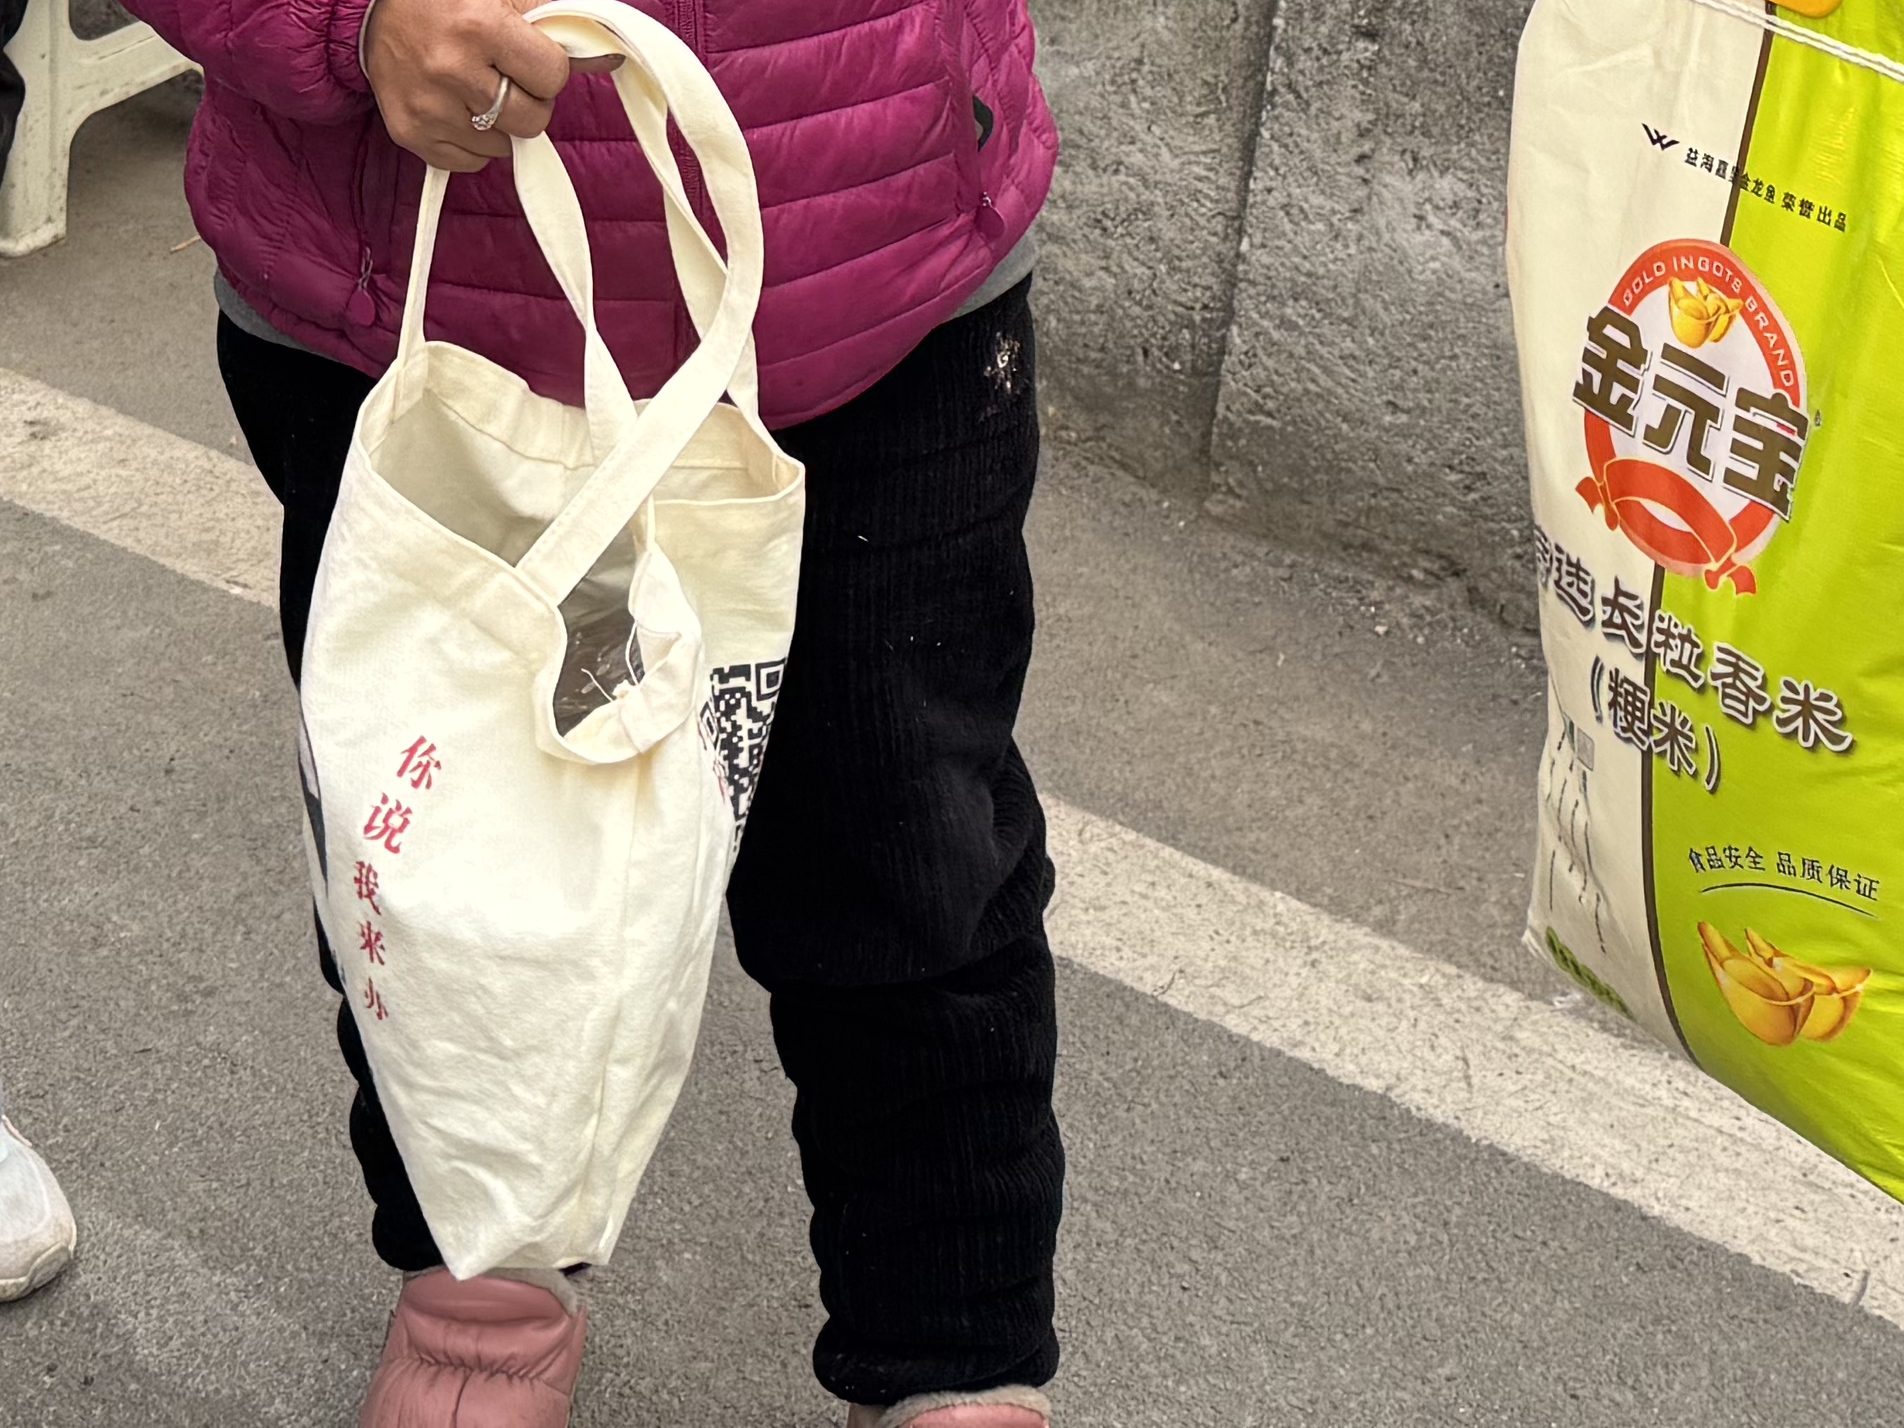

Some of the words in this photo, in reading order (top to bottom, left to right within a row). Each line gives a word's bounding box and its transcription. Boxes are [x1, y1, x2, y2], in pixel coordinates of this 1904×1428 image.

[1623, 260, 1666, 307] GOLD
[1672, 255, 1742, 294] INGOTS
[1745, 295, 1796, 387] BRAND
[1573, 305, 1810, 523] 金元宝
[353, 735, 442, 1021] 你说我来办
[1689, 845, 1766, 874] 食品安全
[1776, 851, 1881, 902] 品质保证
